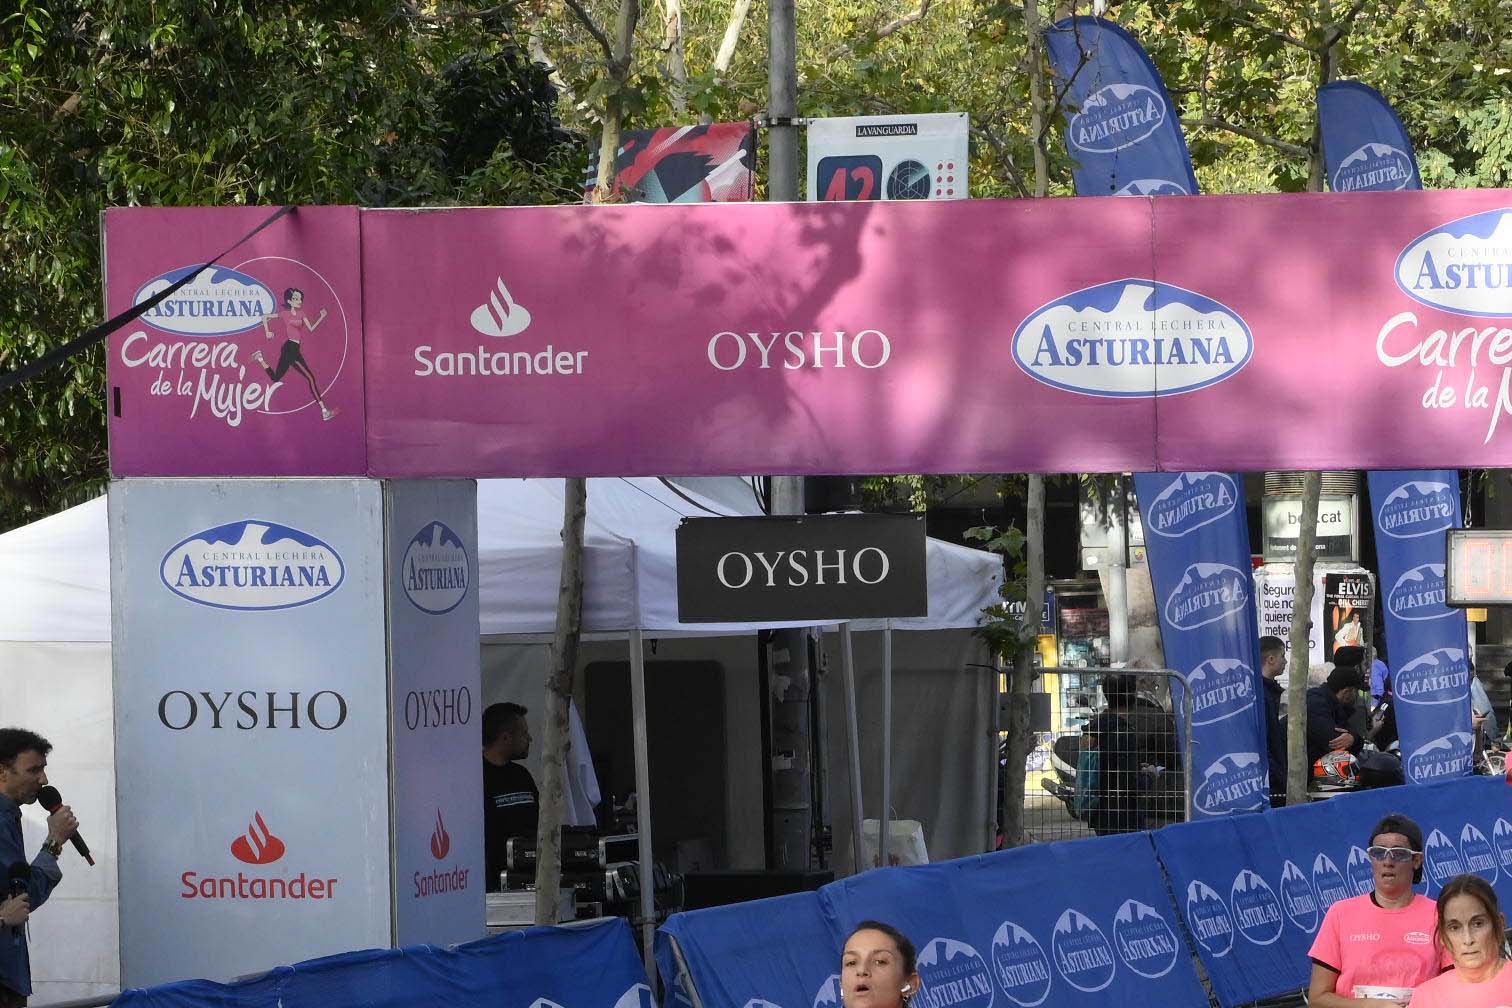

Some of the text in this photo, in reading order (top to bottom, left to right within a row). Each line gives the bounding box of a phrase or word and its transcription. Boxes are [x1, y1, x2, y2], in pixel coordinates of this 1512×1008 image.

[143, 289, 265, 318] ASTURIANA
[214, 289, 261, 297] LECHERA
[1068, 319, 1226, 331] CENTRAL LECHERA
[120, 331, 237, 369] Carrera
[413, 344, 589, 377] Santander
[707, 329, 891, 371] OYSHO
[1031, 322, 1235, 367] ASTURIANA
[151, 373, 193, 396] de la
[190, 365, 283, 427] Mujer
[1421, 367, 1489, 409] de la
[174, 553, 332, 588] ASTURIANA
[203, 551, 325, 561] CENTRAL LECHERA
[716, 547, 890, 589] OYSHO
[407, 558, 466, 592] ASTURIANA
[1338, 582, 1369, 595] ELVIS
[157, 690, 348, 731] OYSHO
[405, 686, 471, 731] OYSHO
[181, 871, 338, 899] Santander
[413, 865, 470, 899] Santander
